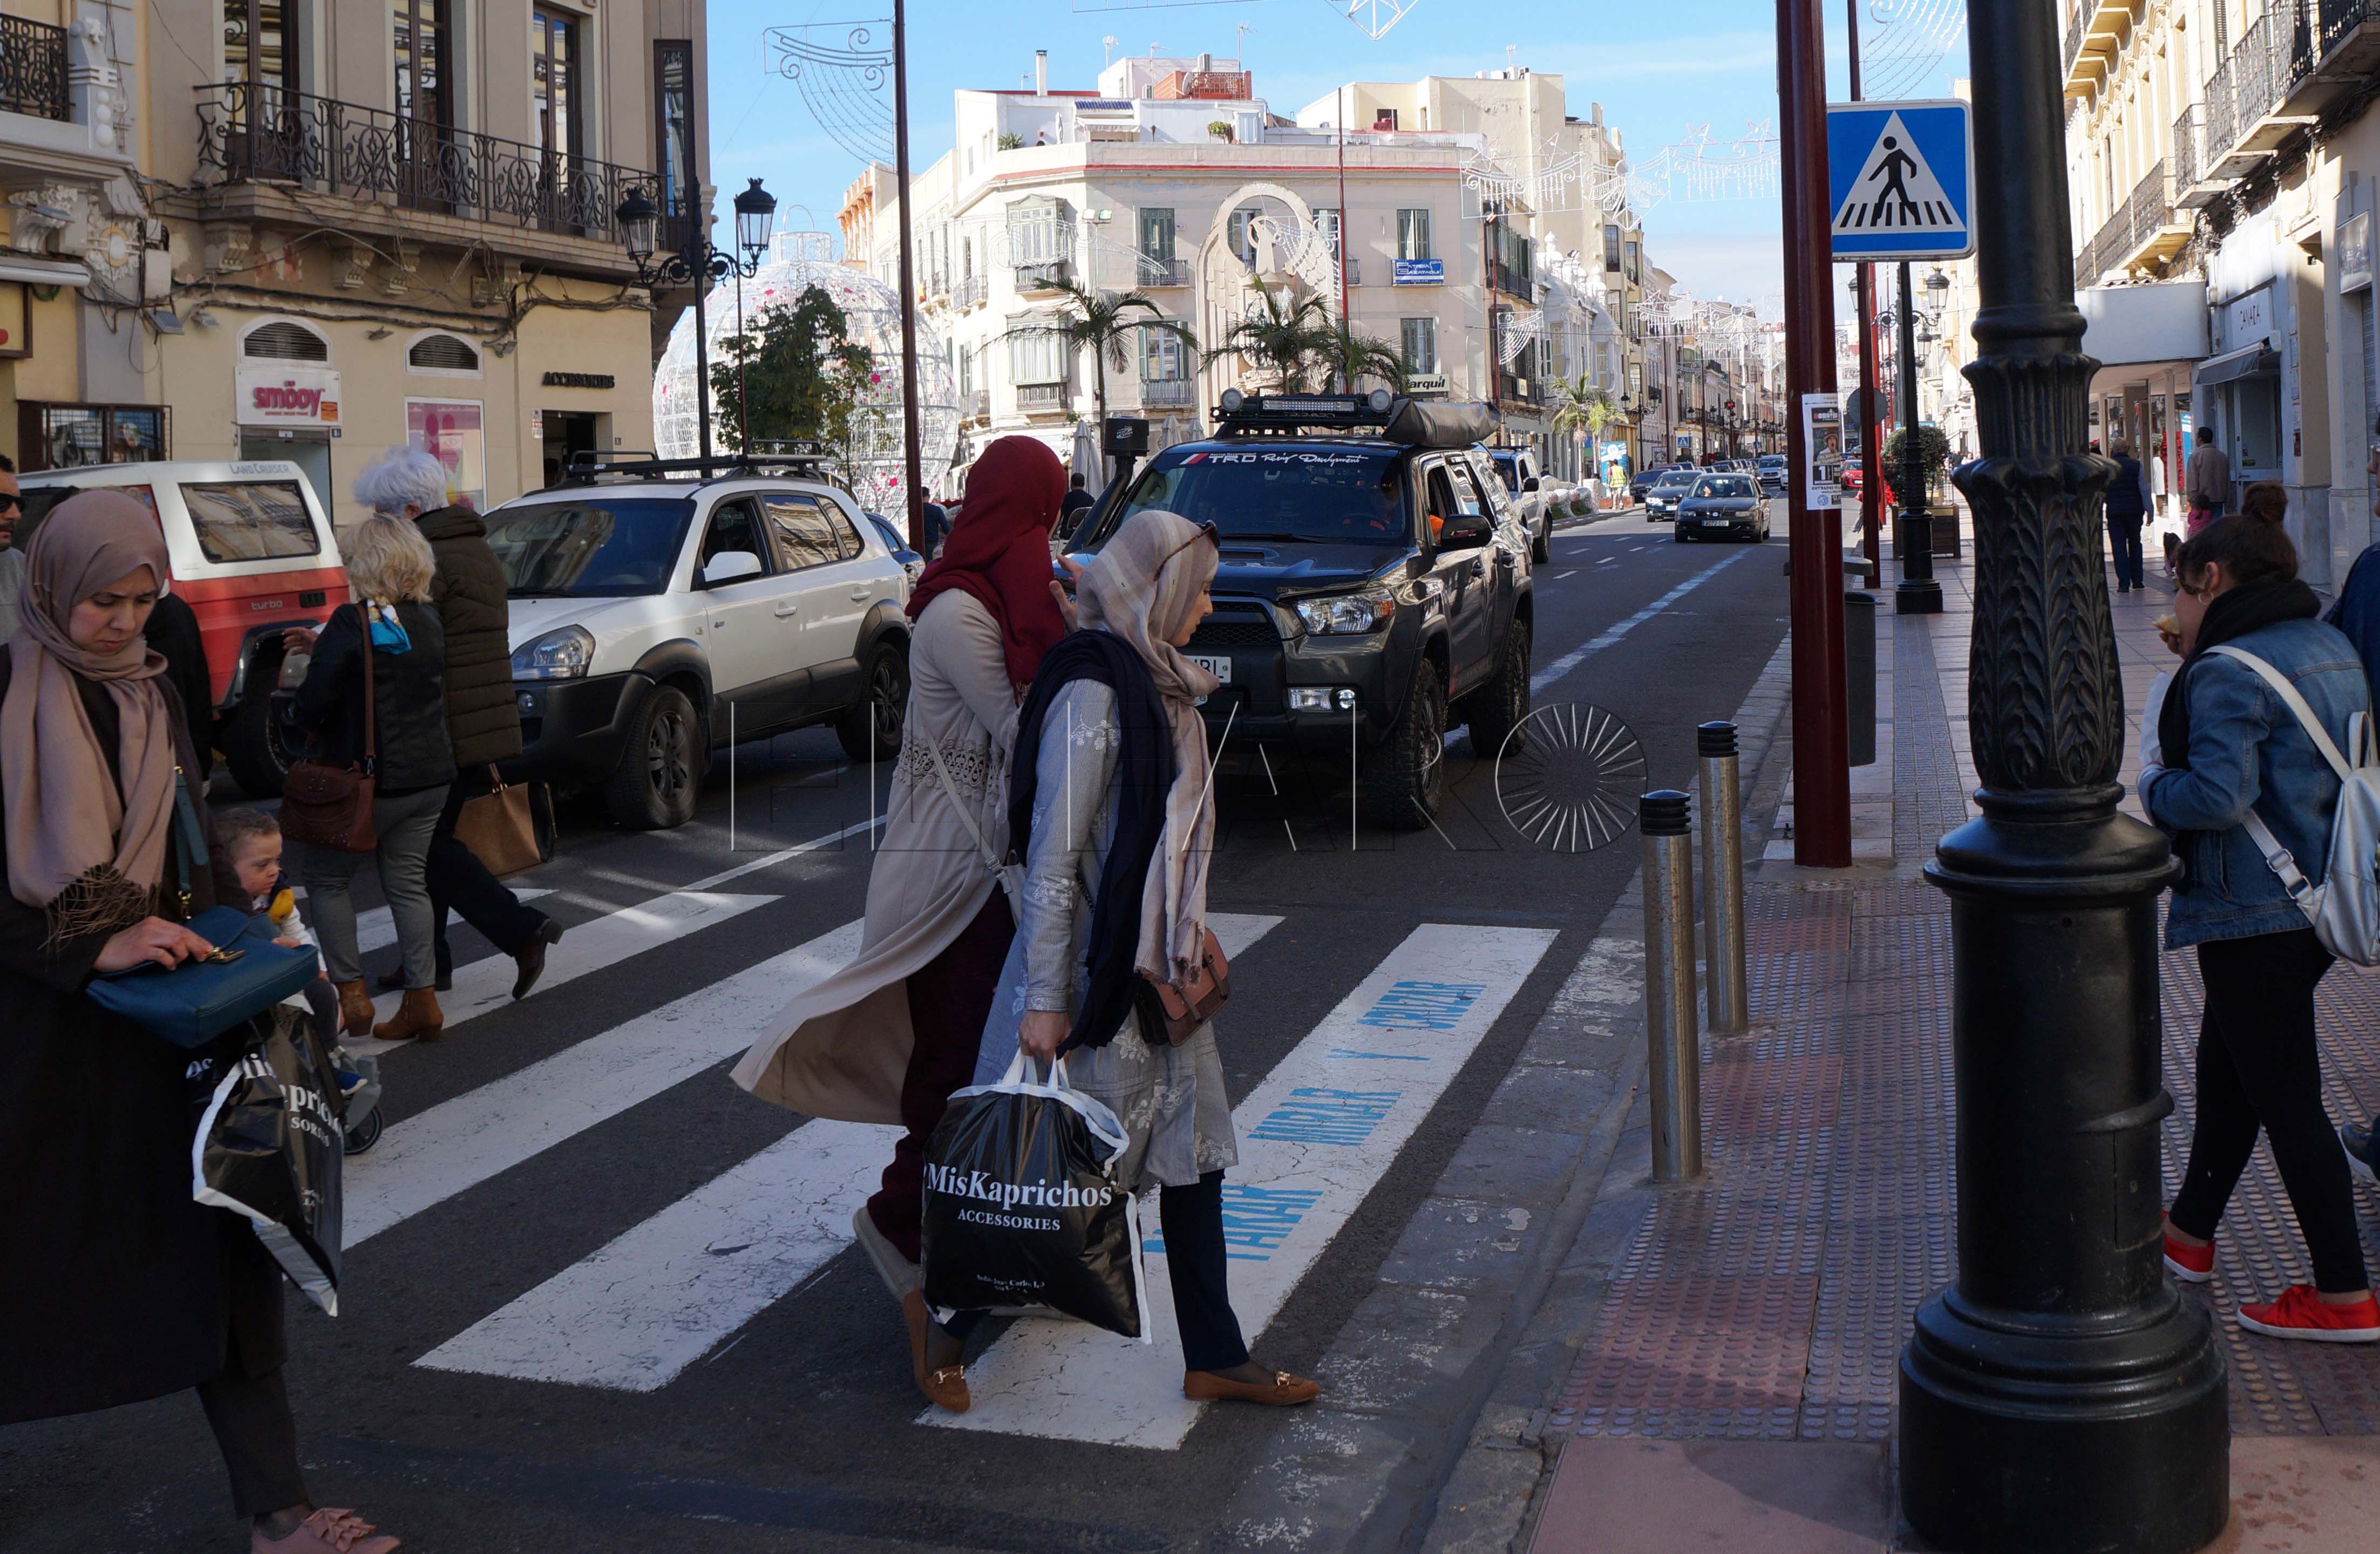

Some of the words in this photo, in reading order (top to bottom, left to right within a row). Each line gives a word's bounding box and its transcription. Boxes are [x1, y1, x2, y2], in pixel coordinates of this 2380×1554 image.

[1408, 376, 1446, 390] arquil
[1209, 455, 1256, 464] TRD
[251, 599, 282, 610] turbo
[1195, 659, 1223, 679] RL
[1247, 1088, 1403, 1147] MIRAR
[1356, 981, 1487, 1030] CRUZAR
[958, 1208, 1060, 1231] ACCESSORIES
